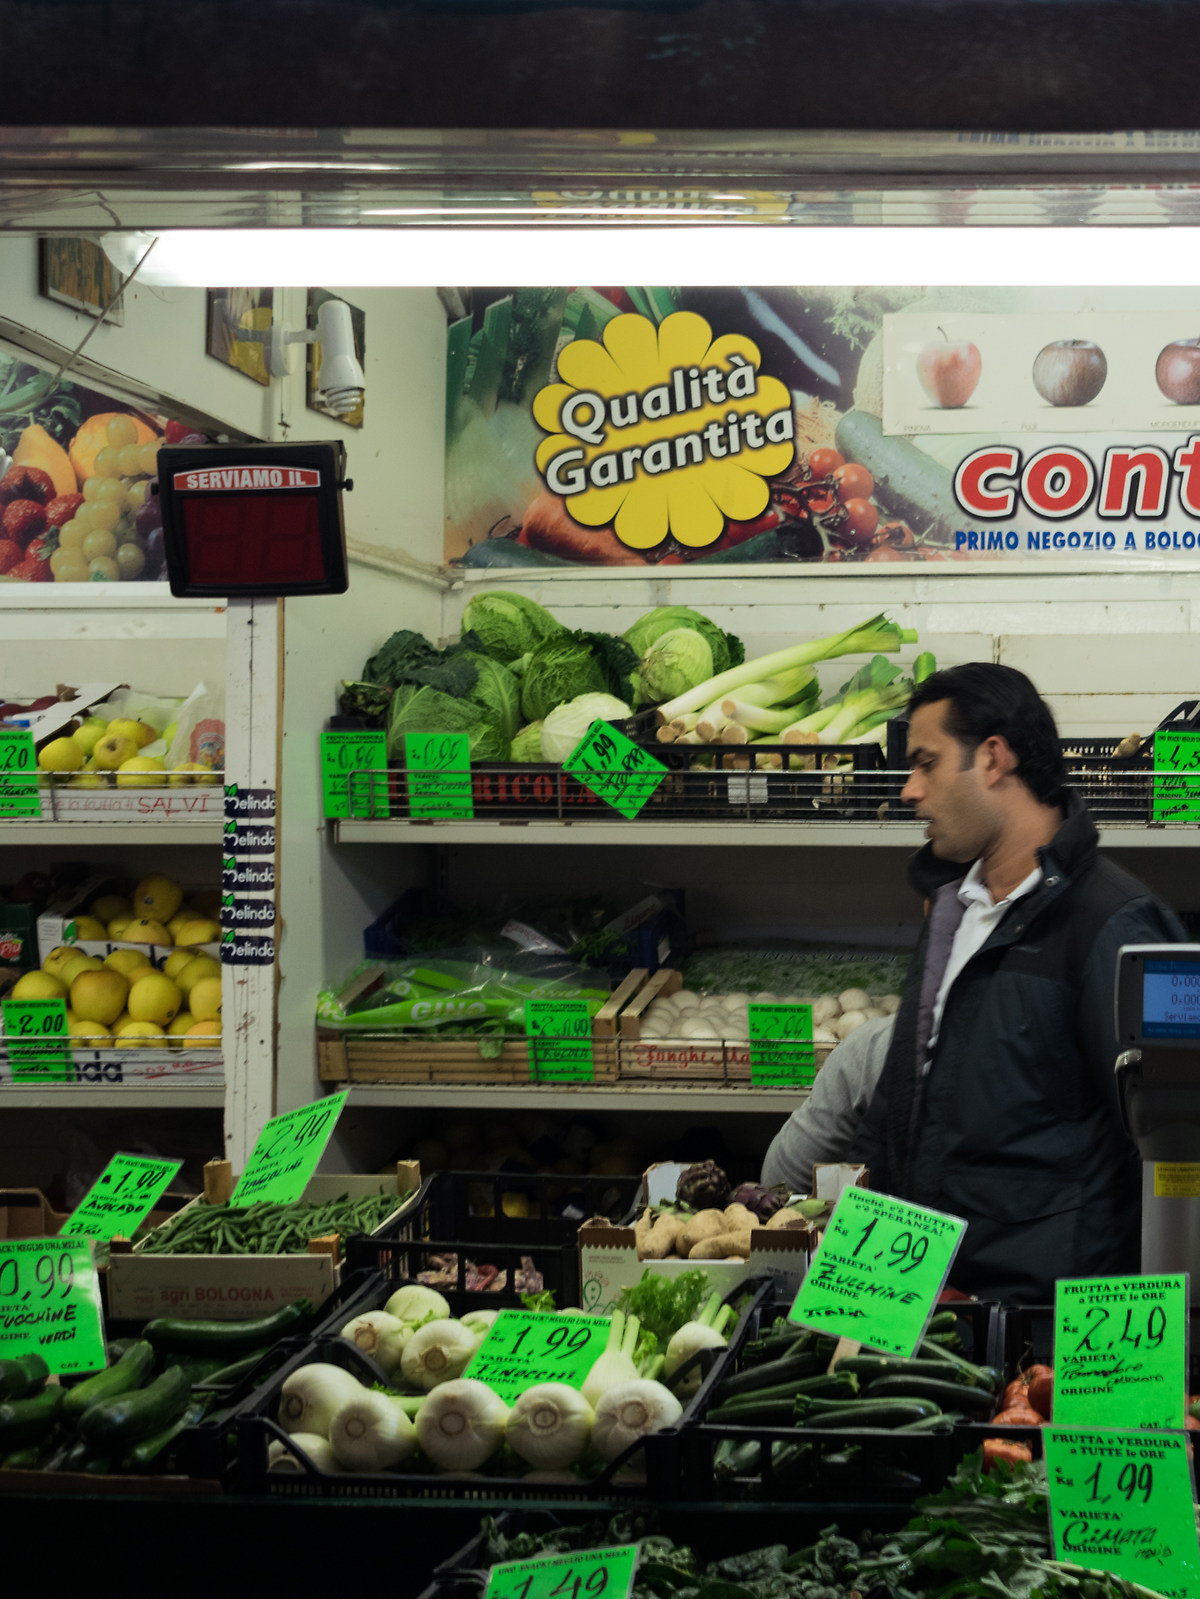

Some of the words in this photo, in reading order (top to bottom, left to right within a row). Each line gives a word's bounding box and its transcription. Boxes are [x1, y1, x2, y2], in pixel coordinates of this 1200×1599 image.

[562, 355, 756, 444] Qualità
[546, 410, 794, 495] Garantita
[187, 470, 282, 489] SERVIAMO
[289, 471, 306, 486] IL
[955, 530, 1019, 551] PRIMO
[1027, 530, 1116, 551] NEGOZIO
[1124, 530, 1136, 551] A
[219, 904, 275, 920] Melinda
[907, 1209, 956, 1232] FRUTTA
[852, 1217, 929, 1274] 1,99
[194, 1287, 275, 1302] BOLOGNA
[810, 1279, 860, 1300] ORIGINE
[1064, 1284, 1111, 1295] FRUTTA
[1123, 1280, 1181, 1291] VERDURA
[1087, 1294, 1126, 1304] TUTTE
[1141, 1291, 1166, 1300] ORE
[1075, 1305, 1167, 1353] 2,49
[511, 1325, 593, 1360] 1,99
[1061, 1386, 1114, 1396] ORIGINE
[1052, 1433, 1104, 1445] FRUTTA
[1117, 1436, 1182, 1449] VERDURA
[1080, 1446, 1123, 1457] TUTTE
[1139, 1449, 1167, 1459] ORE
[1084, 1461, 1154, 1505] 1,99
